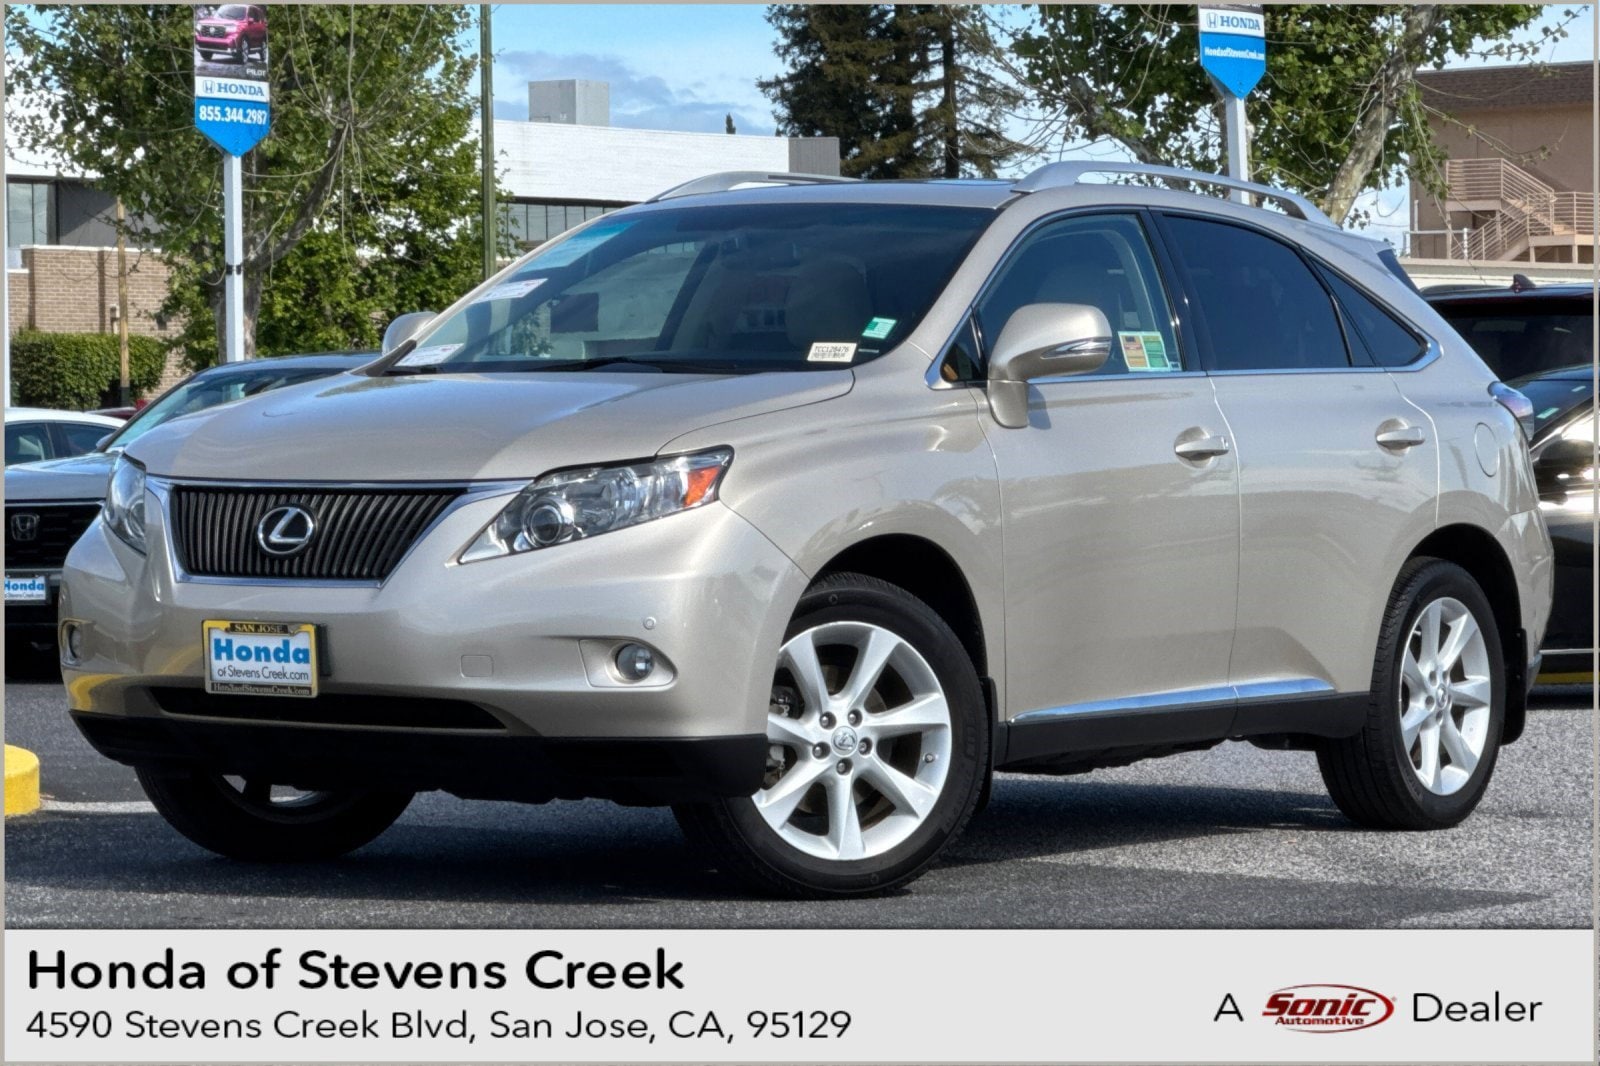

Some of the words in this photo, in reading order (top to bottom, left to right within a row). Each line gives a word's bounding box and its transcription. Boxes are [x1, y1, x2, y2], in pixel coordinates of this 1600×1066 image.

[1219, 15, 1261, 31] HONDA
[246, 68, 266, 77] PILOT
[216, 82, 265, 97] HONDA
[199, 105, 267, 125] 855.344.2987
[234, 624, 255, 632] SAN
[257, 625, 284, 633] JOSE
[213, 638, 310, 664] Honda
[217, 666, 227, 677] of
